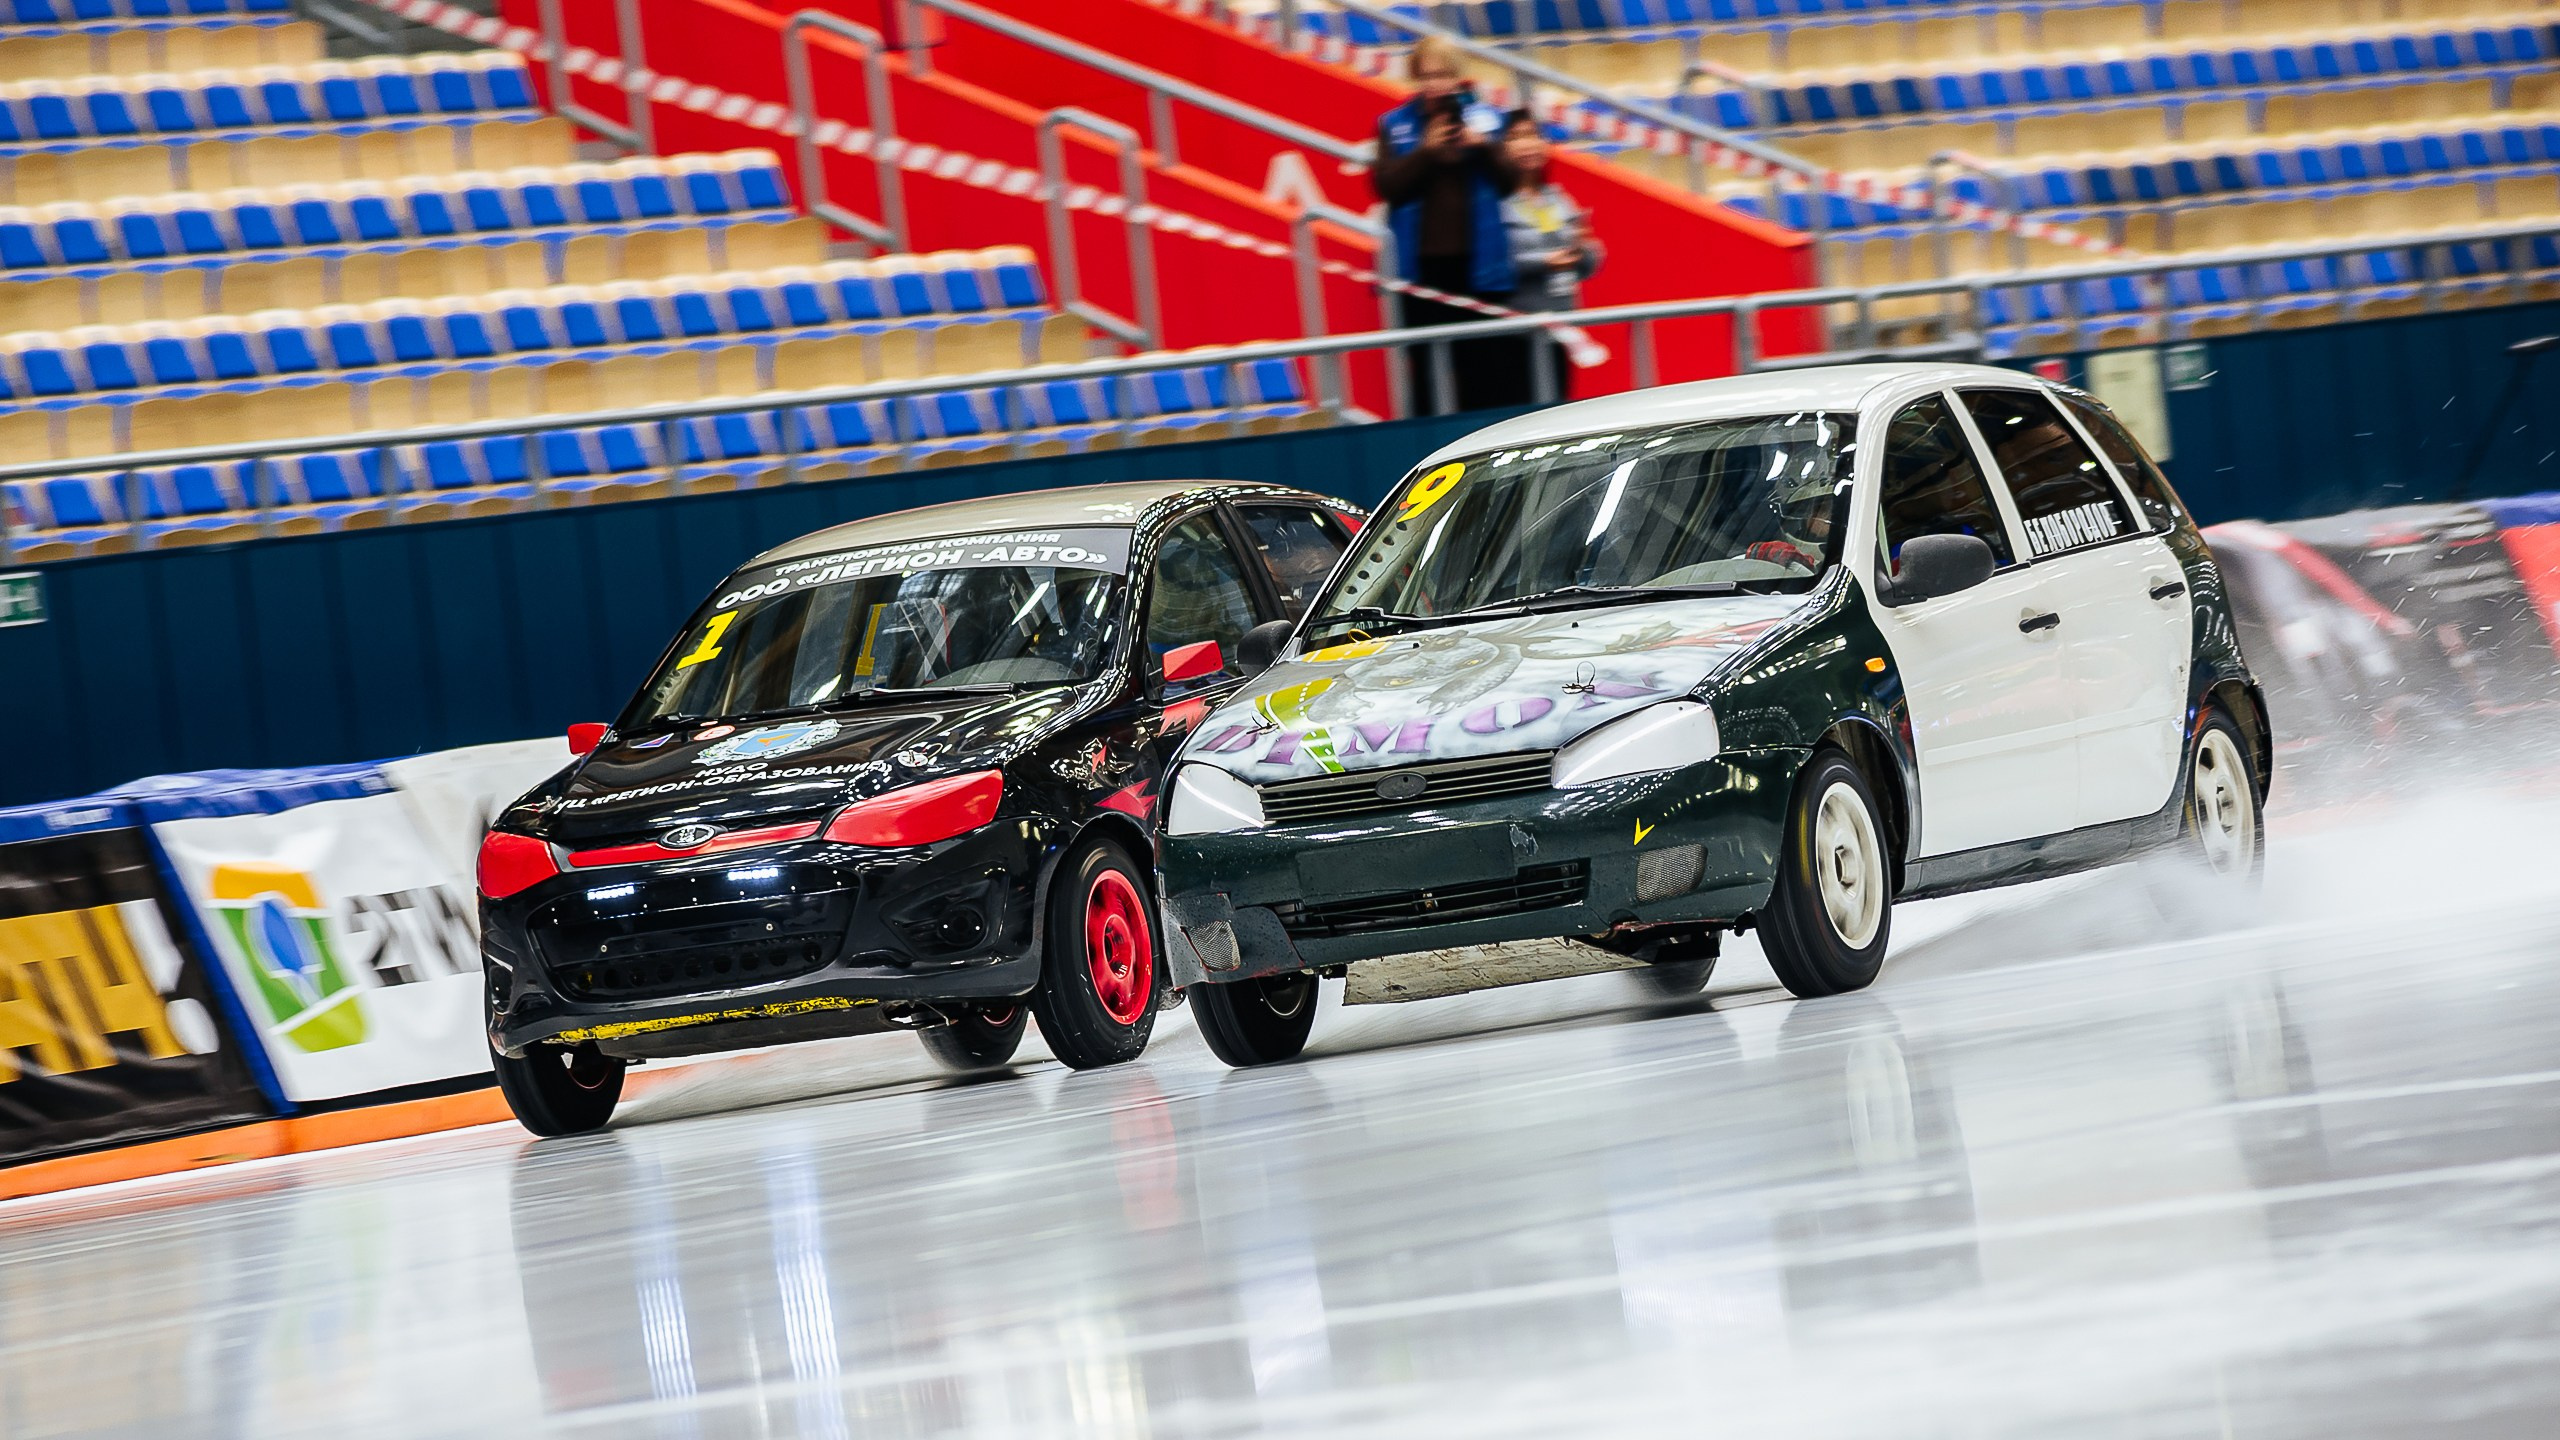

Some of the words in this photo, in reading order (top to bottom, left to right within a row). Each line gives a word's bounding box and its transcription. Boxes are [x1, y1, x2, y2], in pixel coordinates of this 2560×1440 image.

[1397, 462, 1467, 522] 9
[715, 578, 791, 609] ООО
[796, 549, 965, 586] «ЛЕГИОН
[775, 541, 936, 577] ТРАНСПОРТНАЯ
[937, 533, 1062, 549] КОМПАНИЯ
[676, 610, 739, 670] 1
